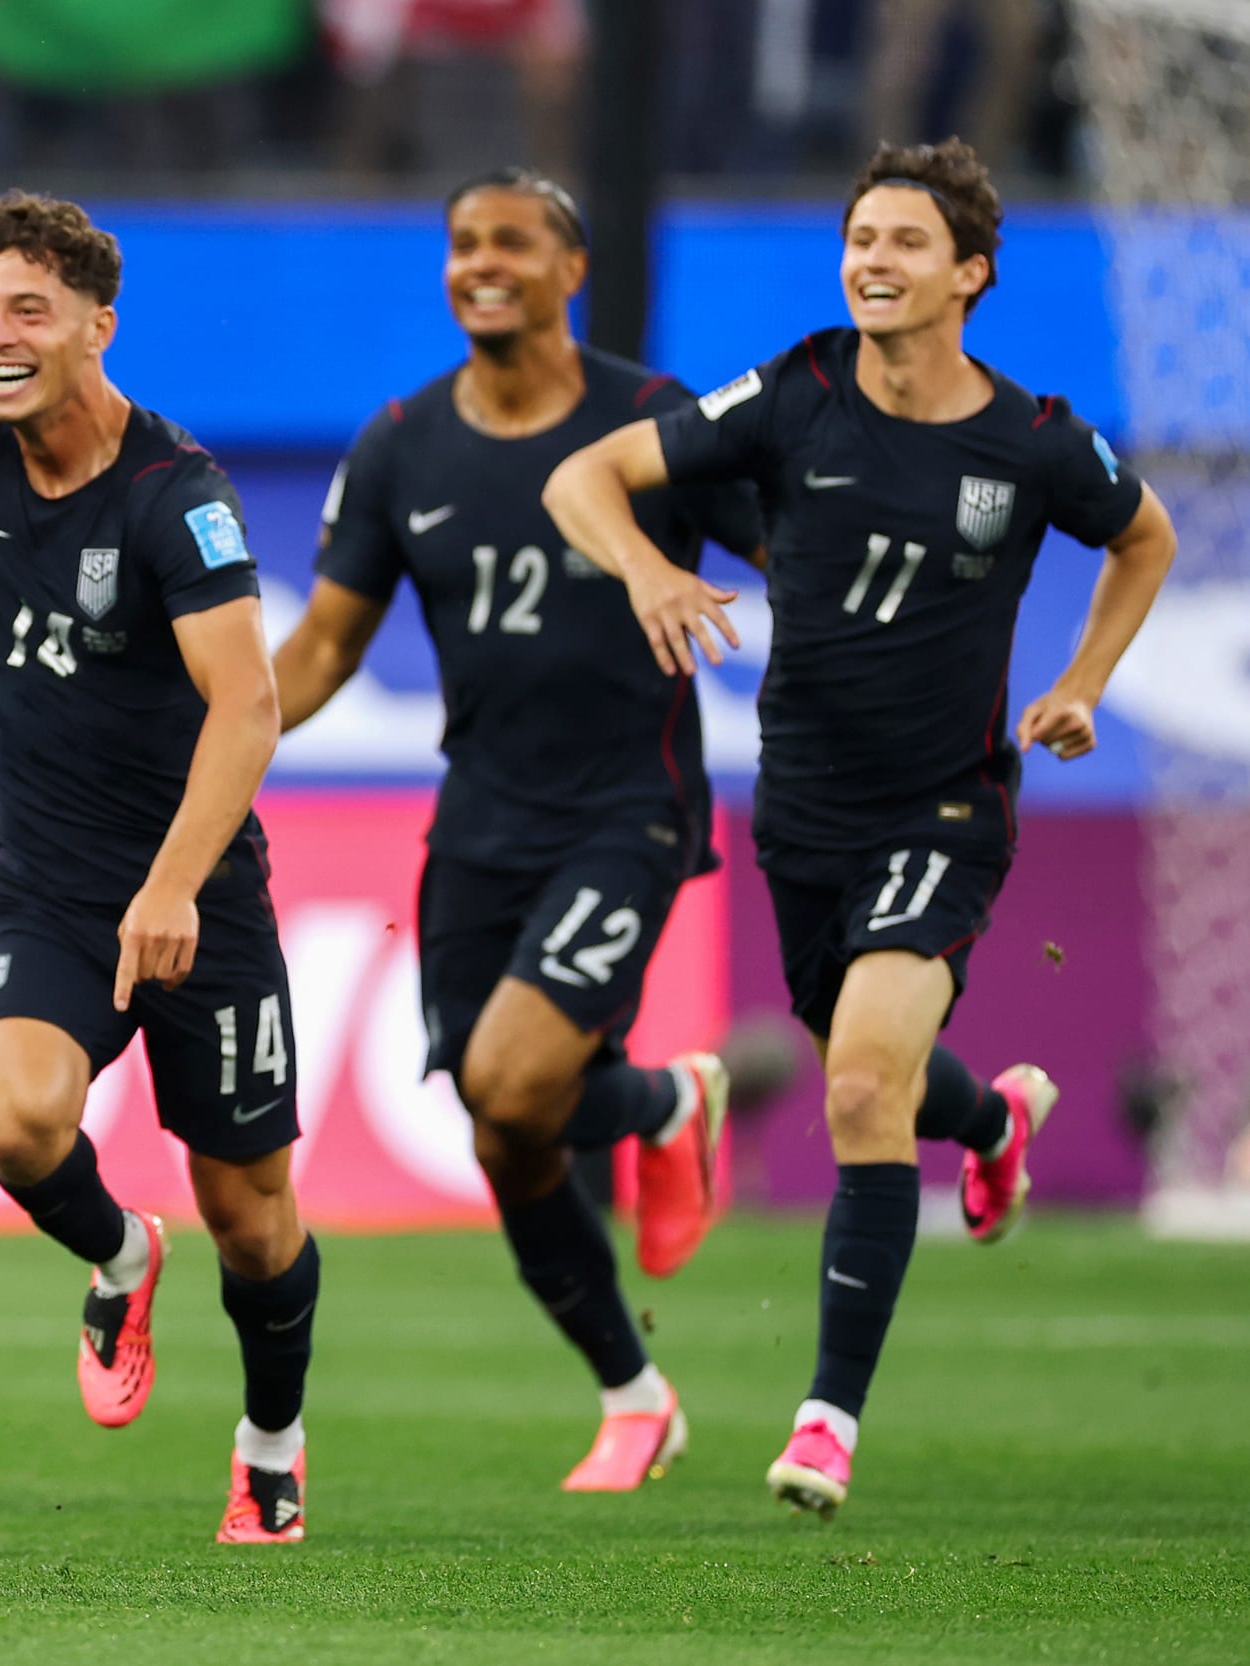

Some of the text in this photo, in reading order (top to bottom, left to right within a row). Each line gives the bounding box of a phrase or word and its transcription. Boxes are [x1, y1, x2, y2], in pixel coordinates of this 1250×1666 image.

[963, 480, 1010, 512] USA
[82, 554, 113, 581] USA
[468, 545, 549, 634] 12
[842, 532, 927, 624] 11
[6, 602, 78, 678] 14
[870, 849, 951, 919] 11
[542, 887, 642, 984] 12
[214, 993, 288, 1095] 14
